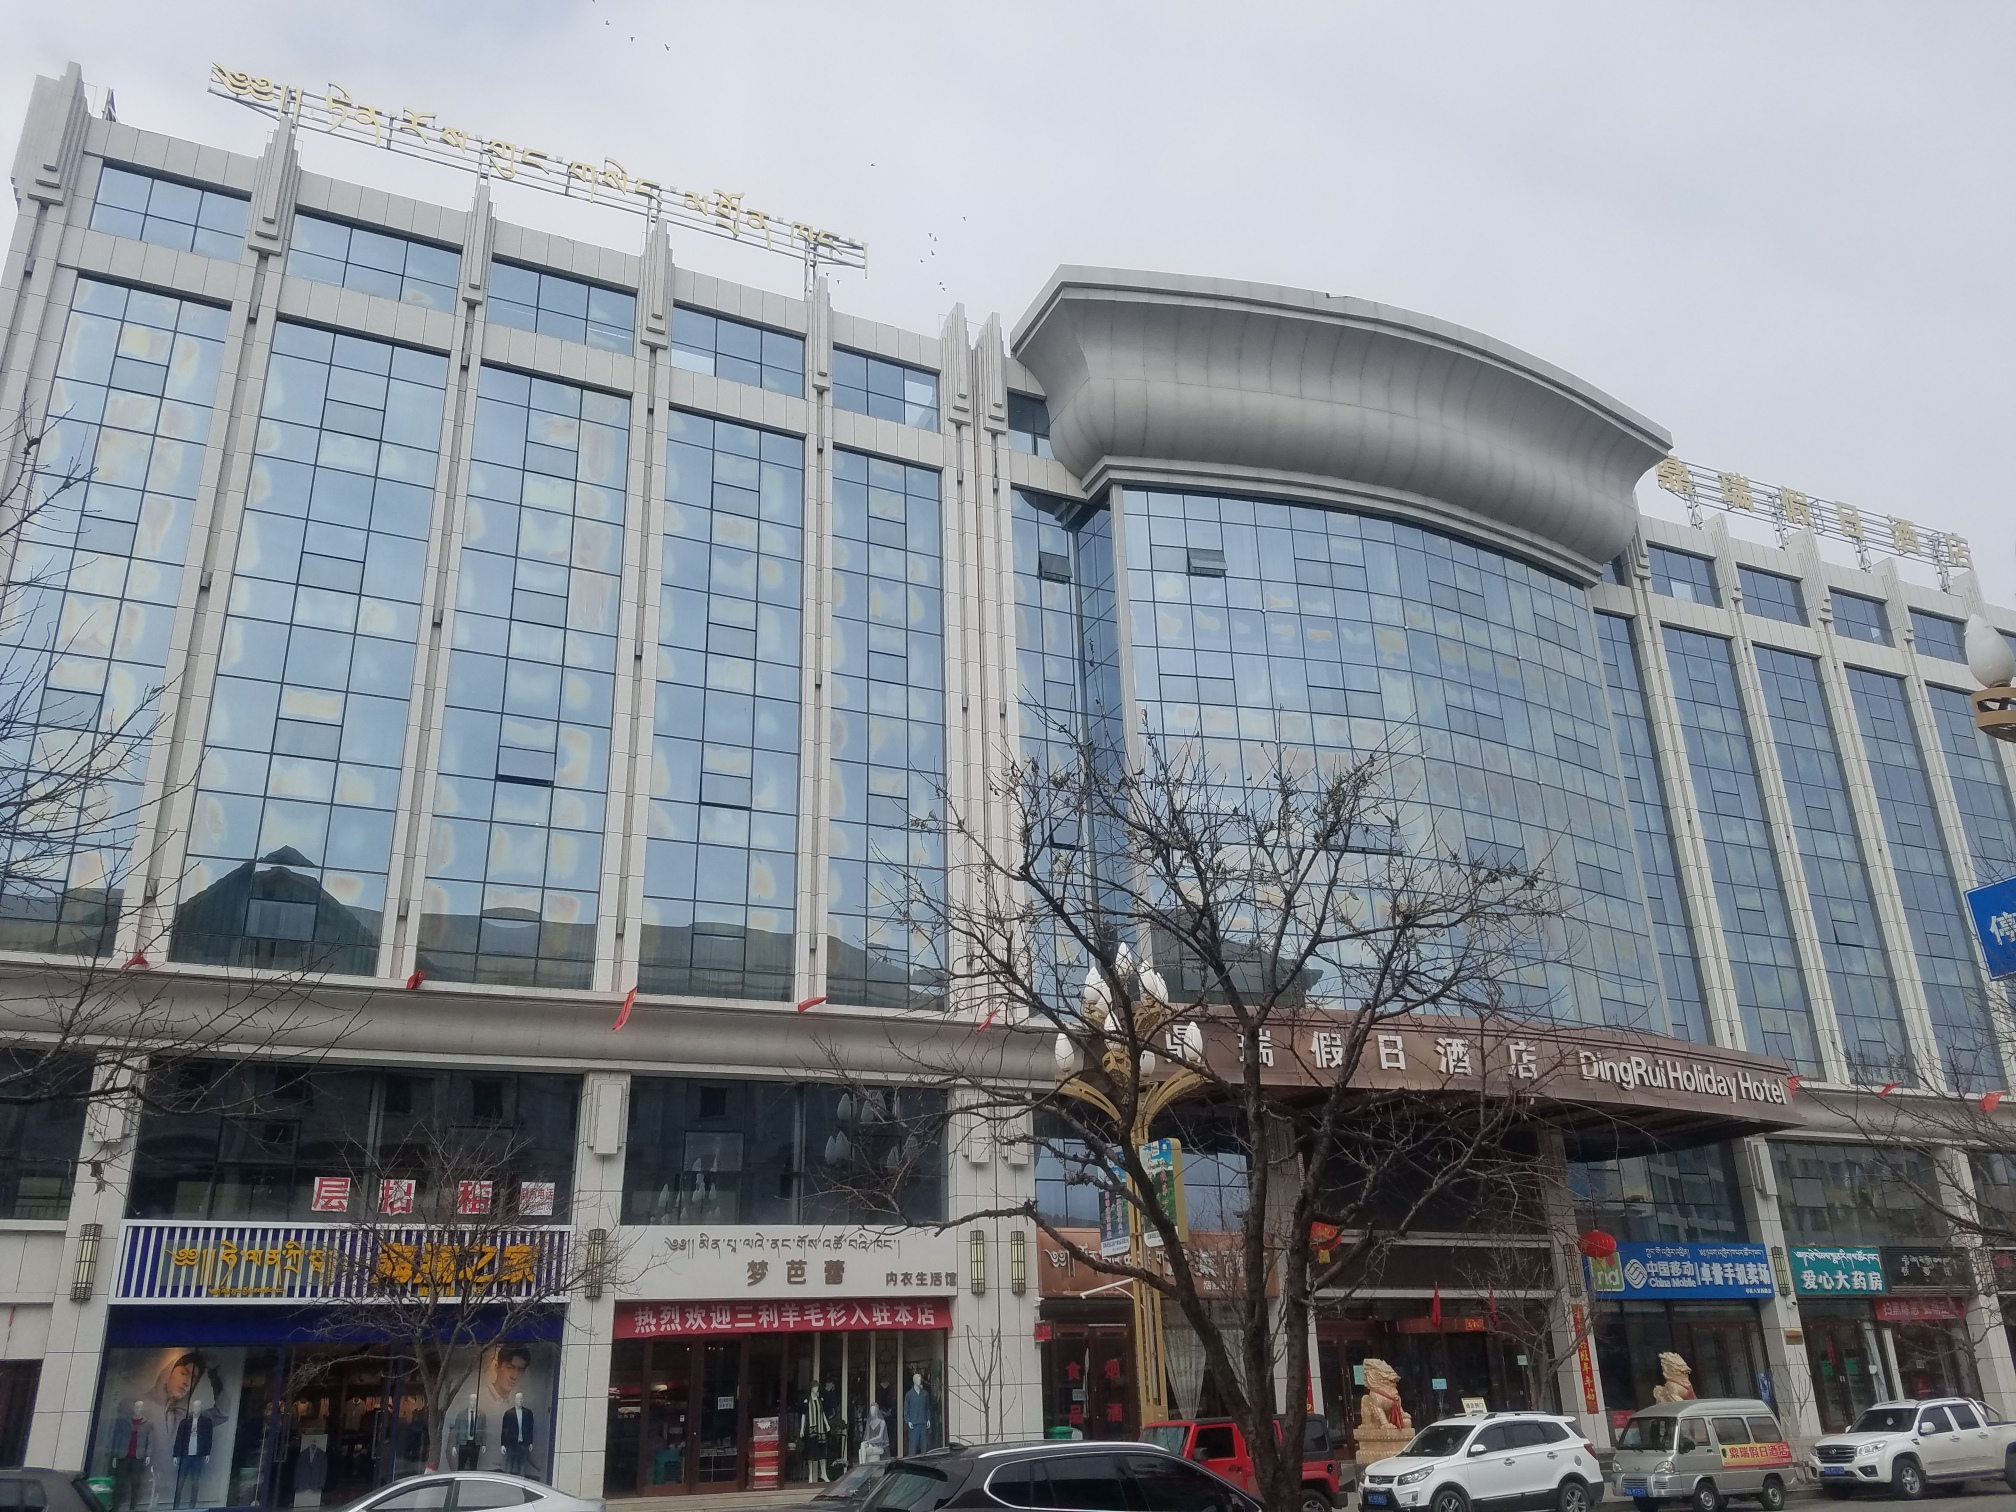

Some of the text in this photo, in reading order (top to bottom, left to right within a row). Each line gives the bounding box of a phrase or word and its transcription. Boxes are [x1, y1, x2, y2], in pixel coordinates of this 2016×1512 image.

[1737, 1071, 1788, 1105] Hotel
[747, 1258, 846, 1287] 梦芭蕾
[1646, 1261, 1695, 1277] 中国移动
[885, 1271, 957, 1287] 内衣生活馆
[1649, 1277, 1697, 1288] China Mobile
[1800, 1269, 1883, 1291] 爱心大药房
[634, 1303, 936, 1334] 热烈欢迎三利羊毛衫入驻本店
[1728, 1443, 1789, 1460] 鼎瑞假日酒店
